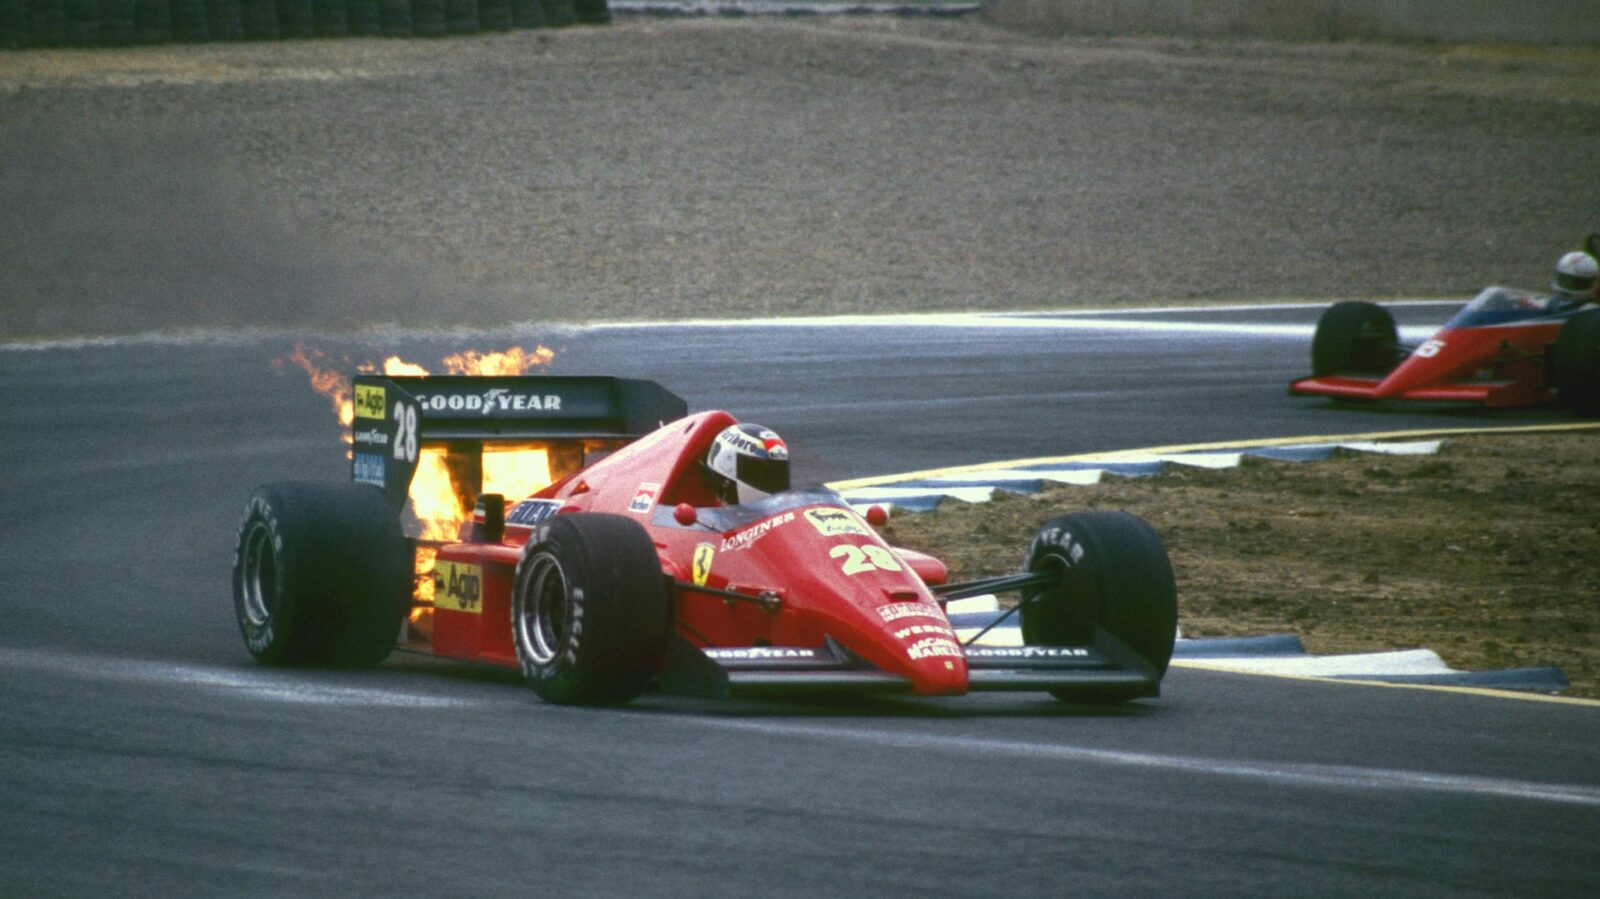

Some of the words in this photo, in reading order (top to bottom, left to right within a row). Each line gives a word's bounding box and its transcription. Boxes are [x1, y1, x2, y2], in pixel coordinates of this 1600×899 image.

[393, 400, 417, 463] 28
[722, 431, 758, 452] arlboro
[512, 503, 556, 521] FIAT
[720, 512, 795, 552] LONGINES
[828, 544, 903, 576] 28
[448, 563, 480, 609] Agip
